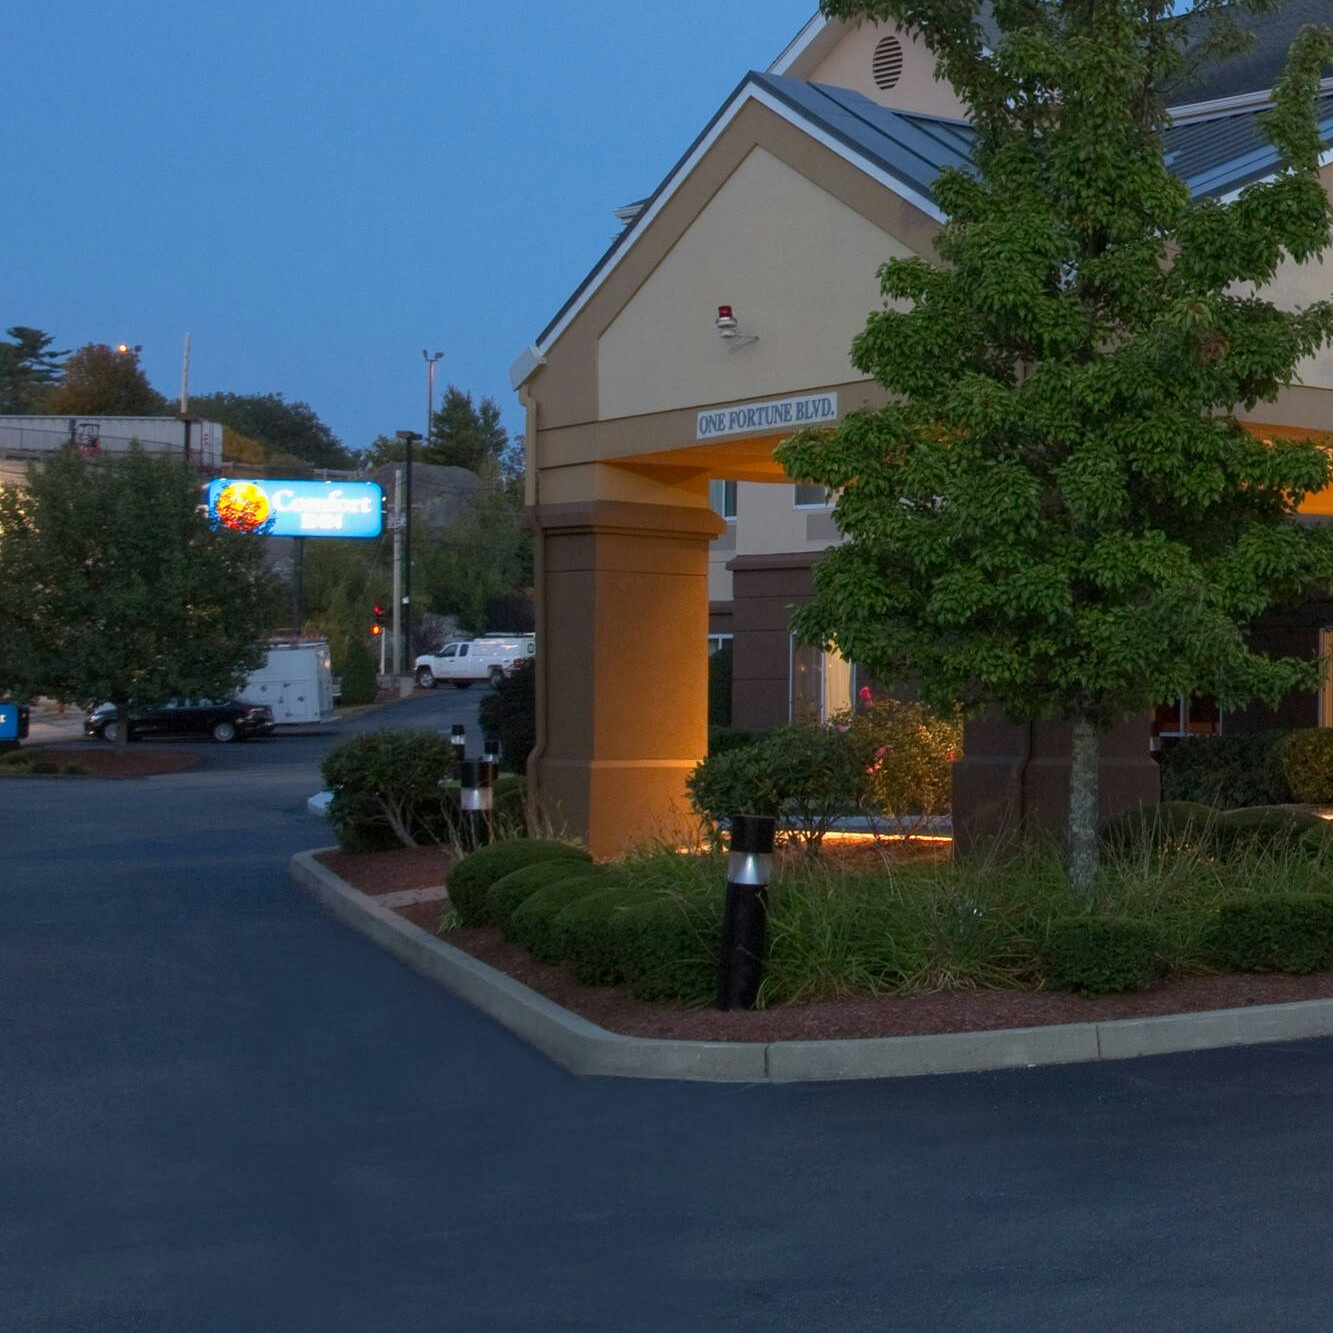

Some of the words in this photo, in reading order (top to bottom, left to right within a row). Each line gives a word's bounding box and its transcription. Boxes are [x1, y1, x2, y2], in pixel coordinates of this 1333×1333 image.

[699, 412, 726, 435] ONE
[728, 403, 793, 431] FORTUNE
[794, 397, 836, 421] BLVD.
